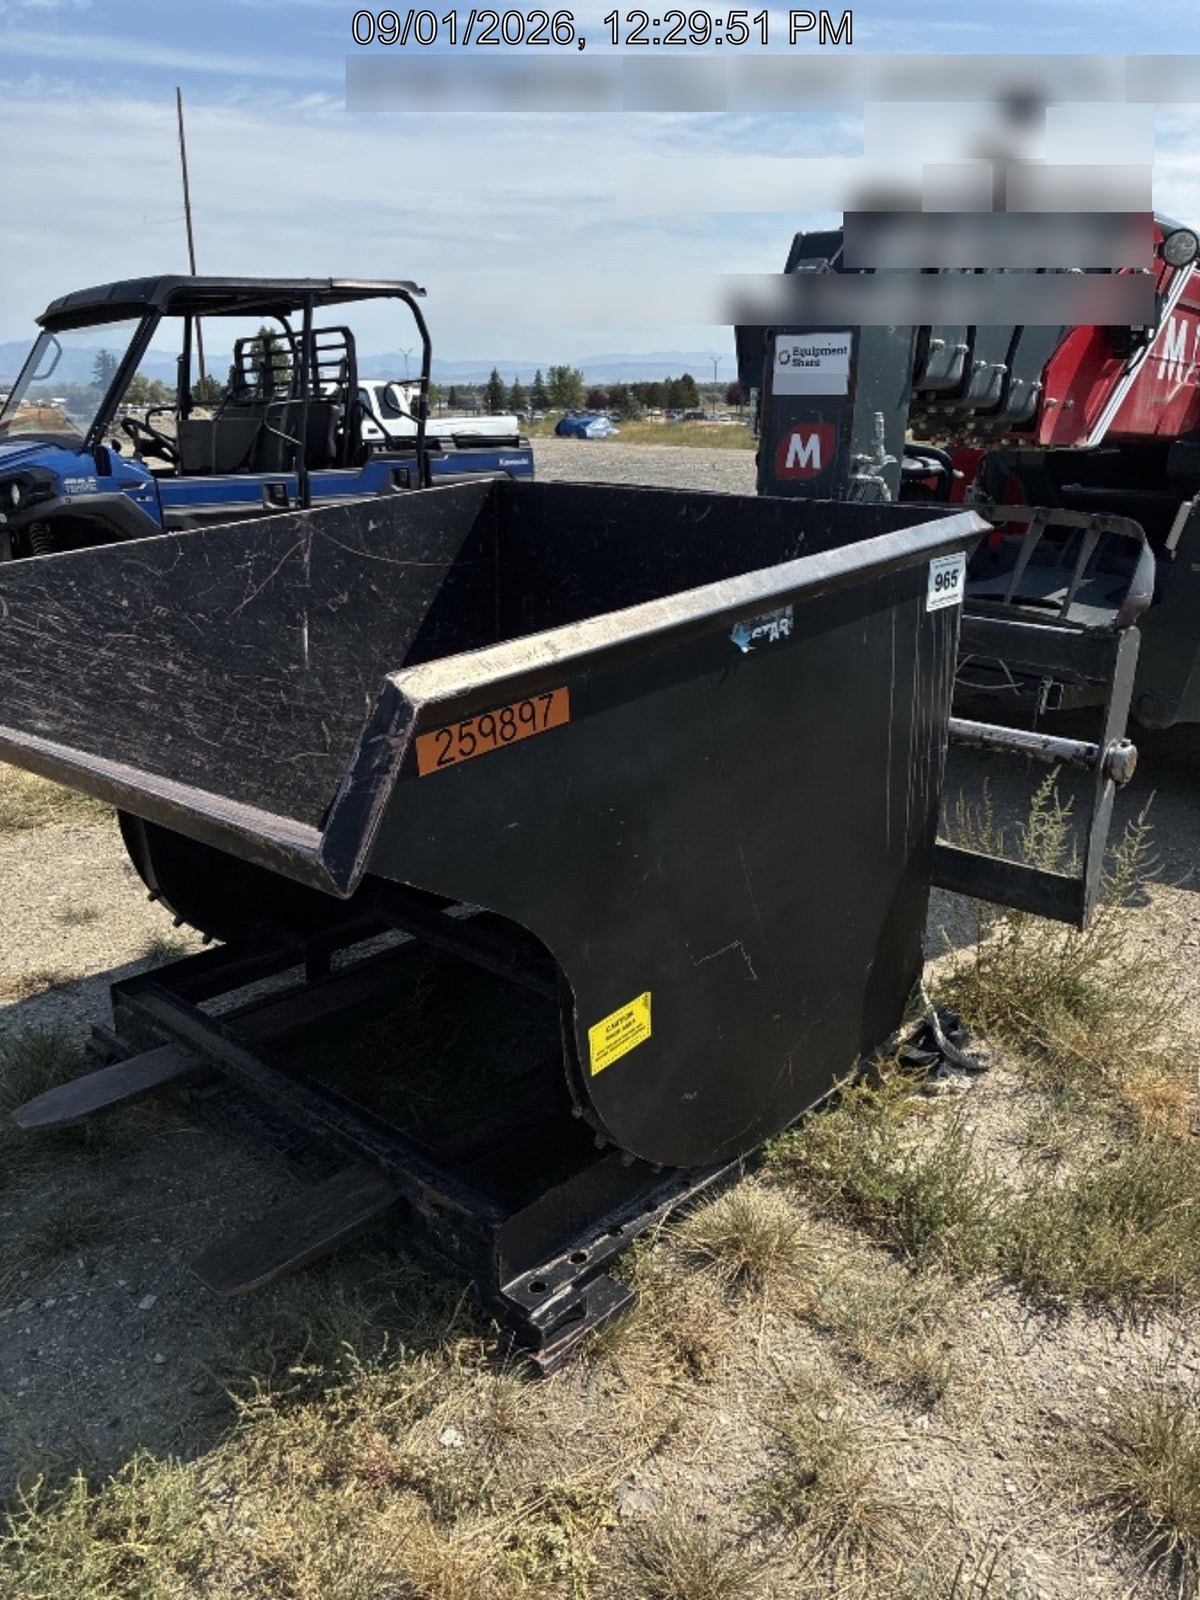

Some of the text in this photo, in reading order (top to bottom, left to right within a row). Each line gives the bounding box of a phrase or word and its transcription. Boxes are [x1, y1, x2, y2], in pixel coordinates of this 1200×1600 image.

[792, 346, 848, 357] Equipment
[1157, 316, 1200, 383] M
[785, 433, 821, 469] M
[934, 569, 959, 593] 965
[435, 693, 554, 766] 259897
